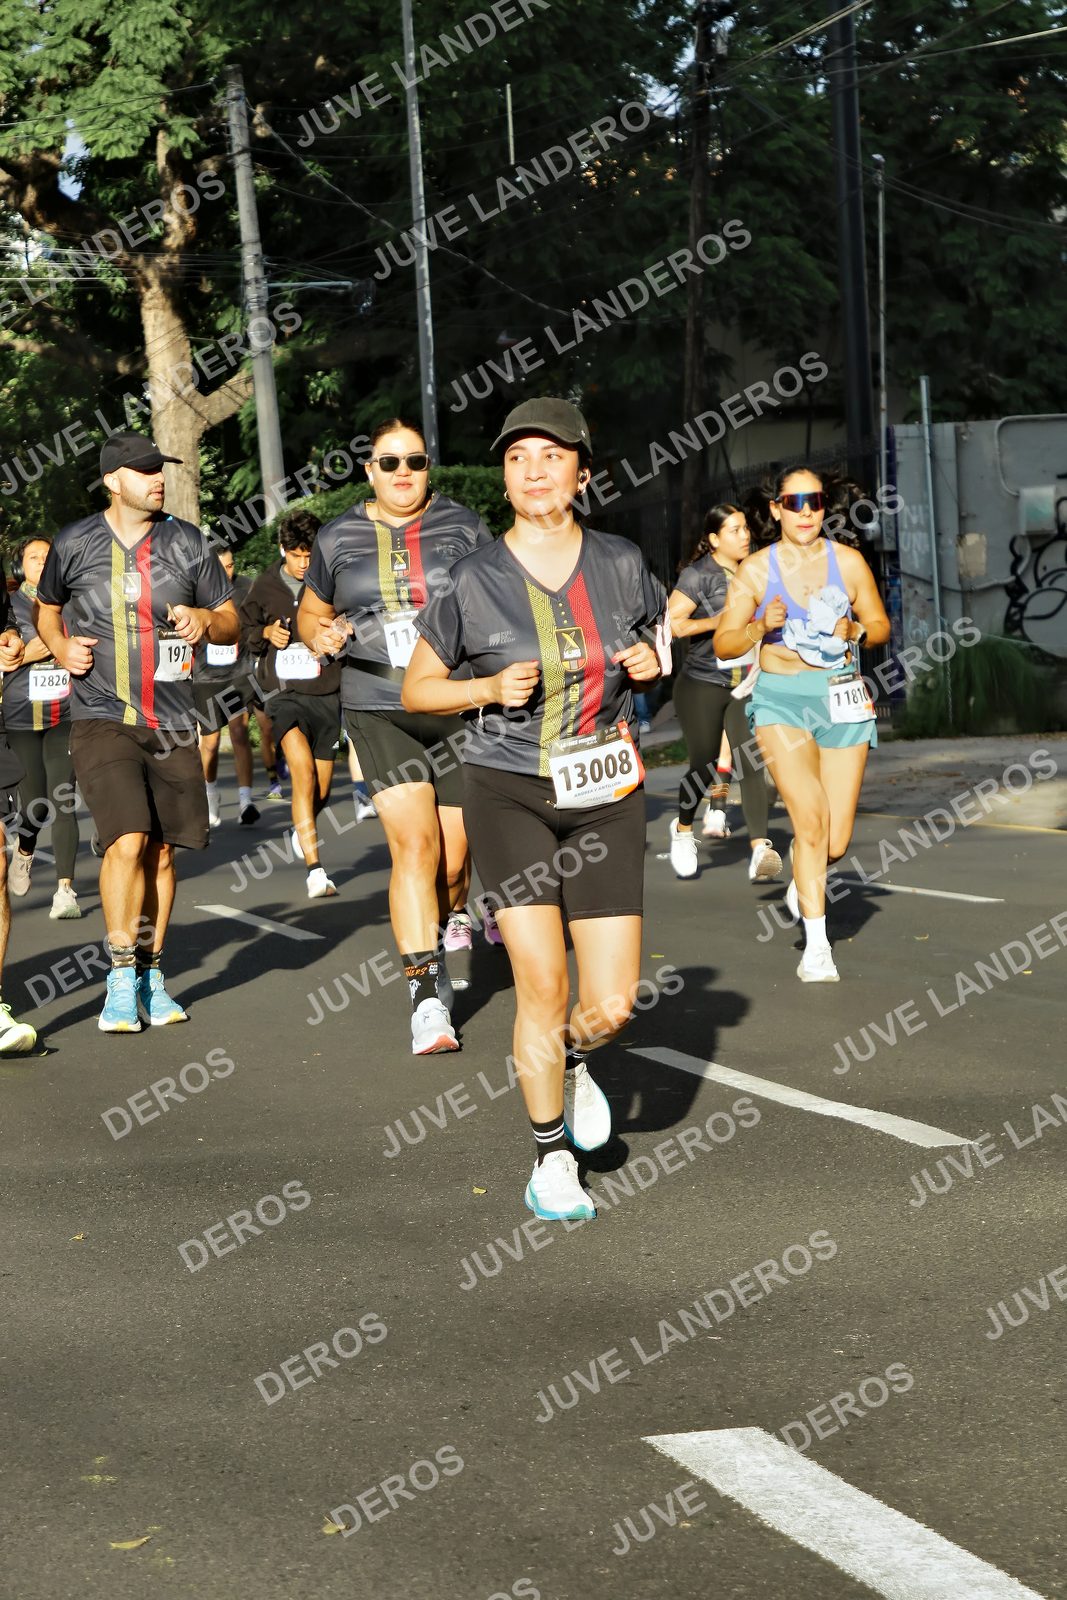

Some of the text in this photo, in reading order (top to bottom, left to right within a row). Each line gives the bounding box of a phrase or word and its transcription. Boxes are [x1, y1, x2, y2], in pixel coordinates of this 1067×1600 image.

[281, 654, 318, 665] 8352
[33, 674, 67, 687] 12826
[558, 749, 632, 791] 13008
